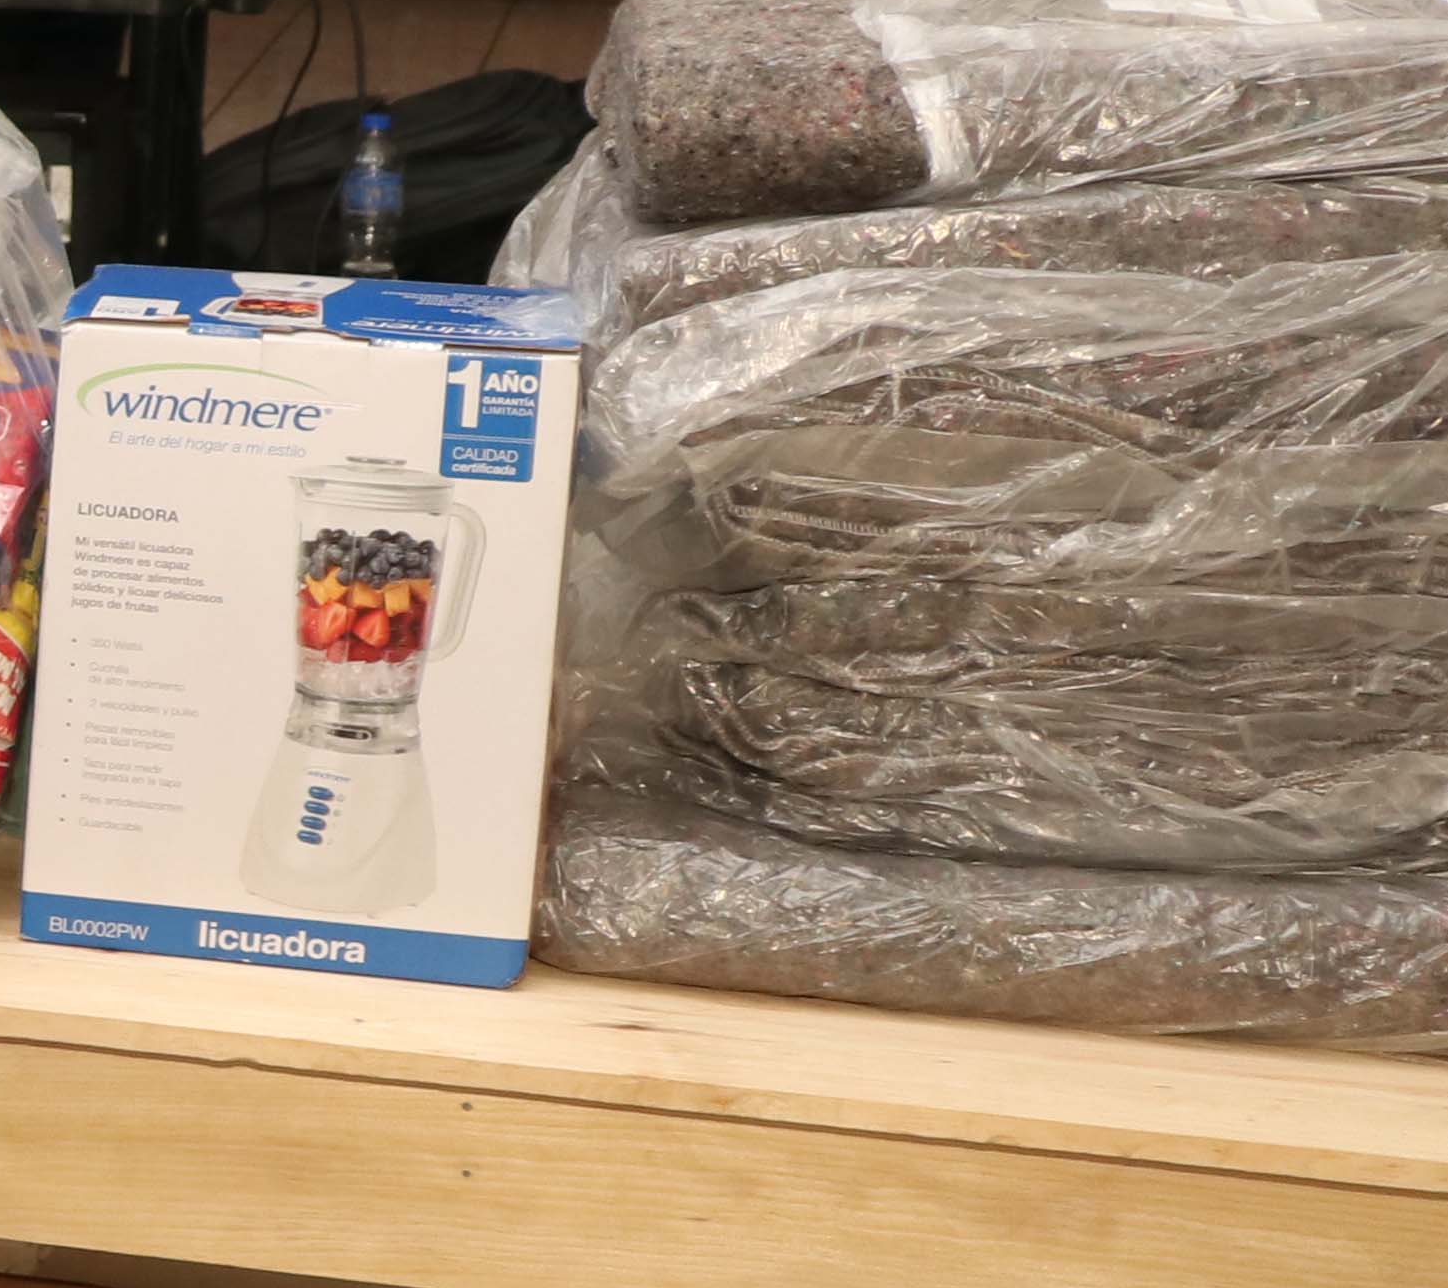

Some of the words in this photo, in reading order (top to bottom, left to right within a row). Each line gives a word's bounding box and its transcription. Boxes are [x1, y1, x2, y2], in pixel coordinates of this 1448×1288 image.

[448, 360, 483, 428] 1
[484, 369, 539, 394] AÑO
[104, 384, 323, 432] windmere
[481, 406, 535, 417] LIMITADA
[108, 430, 124, 445] El
[126, 433, 156, 447] arte
[159, 433, 183, 449] del
[185, 435, 229, 455] hogar
[267, 441, 307, 459] estilo
[452, 445, 519, 464] CALIDAD
[451, 461, 517, 476] certificada
[77, 502, 180, 524] LICUADORA
[75, 535, 91, 547] Mi
[138, 541, 195, 557] licuadora
[74, 550, 135, 566] Windmere
[154, 560, 191, 572] capaz
[73, 566, 88, 577] de
[91, 569, 145, 583] procesar
[147, 573, 205, 588] alimentos
[70, 596, 104, 610] jugos
[106, 599, 122, 611] de
[124, 600, 160, 614] frutas
[163, 588, 224, 605] deliciosos
[48, 915, 150, 941] BL0002PW
[198, 919, 367, 964] licuadora
